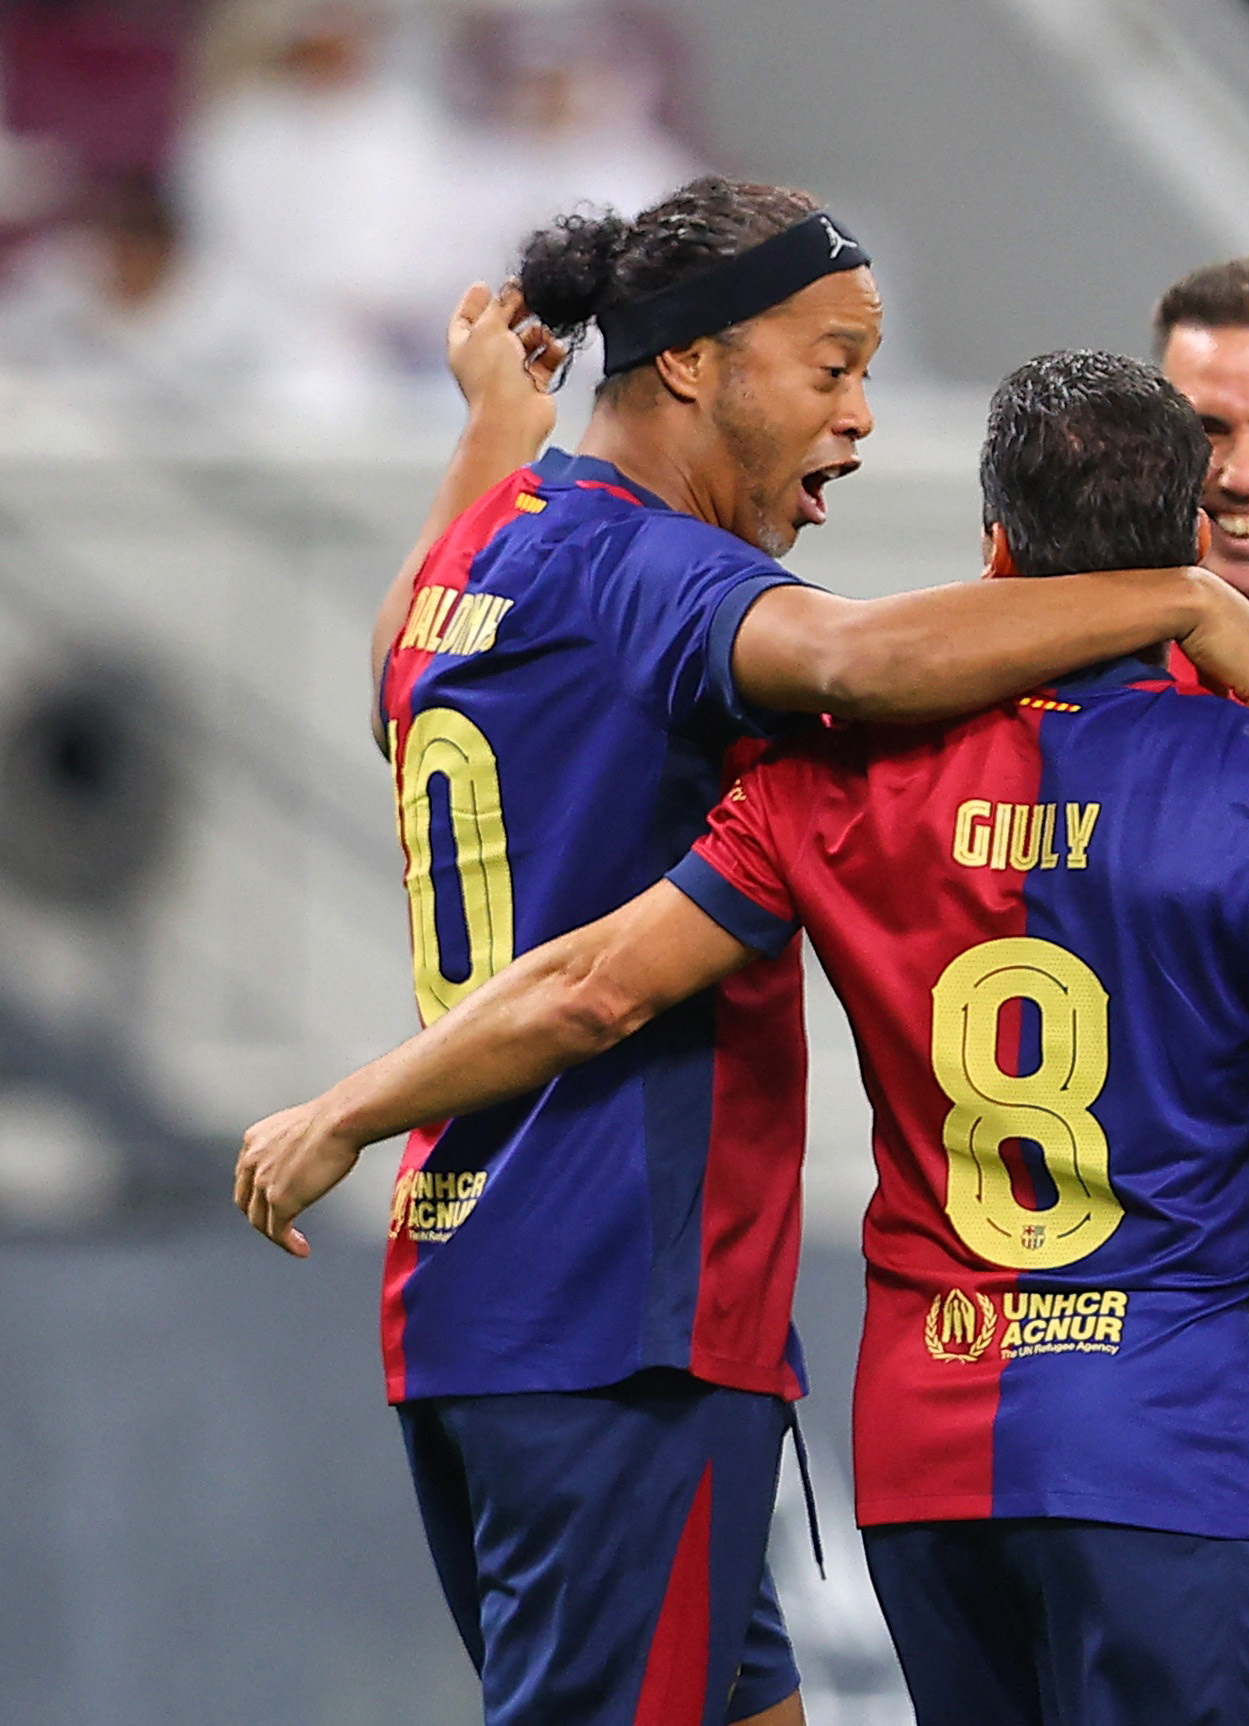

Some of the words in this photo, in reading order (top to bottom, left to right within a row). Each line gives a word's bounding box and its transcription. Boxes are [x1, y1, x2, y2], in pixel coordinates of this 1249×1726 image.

[952, 799, 1100, 871] GIULY
[388, 706, 514, 1030] 0
[931, 937, 1125, 1270] 8
[1003, 1291, 1128, 1320] UNHCR
[1000, 1316, 1123, 1348] ACNUR
[1001, 1349, 1018, 1360] The
[1019, 1346, 1034, 1357] UN
[1034, 1343, 1076, 1355] Refugee
[1076, 1341, 1120, 1355] Agency
